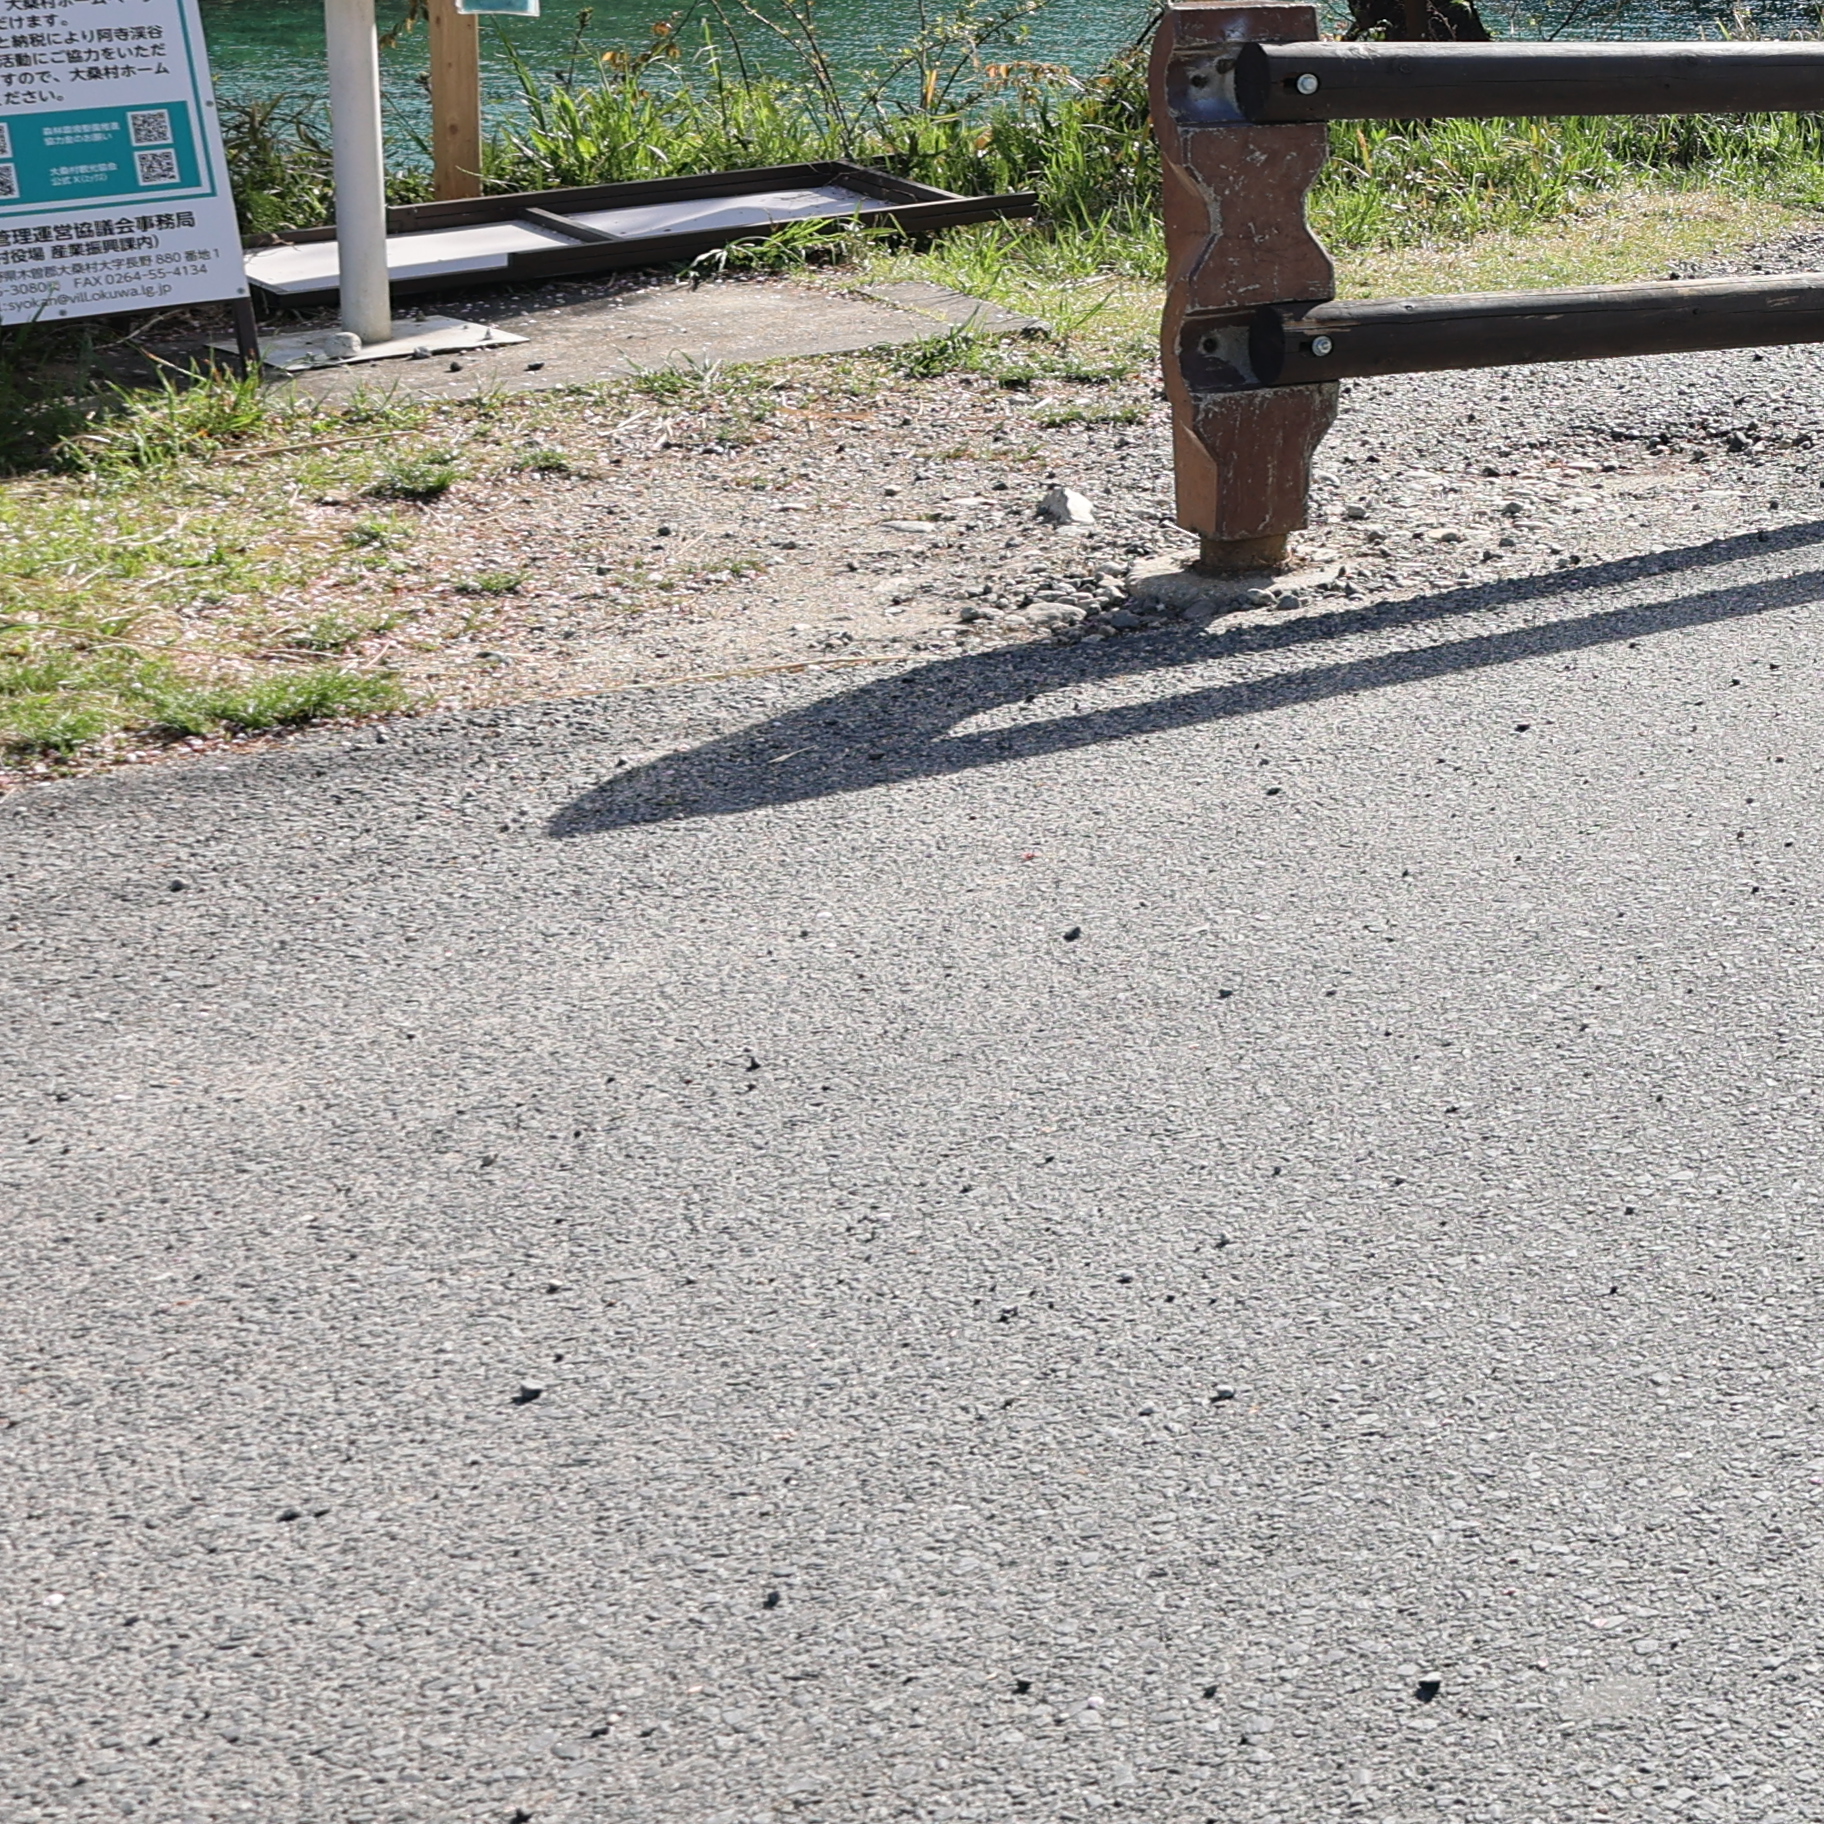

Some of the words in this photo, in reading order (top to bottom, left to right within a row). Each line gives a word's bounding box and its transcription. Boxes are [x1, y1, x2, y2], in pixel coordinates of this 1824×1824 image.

[156, 252, 182, 264] 880
[74, 276, 103, 288] FAX
[104, 264, 208, 285] 0264-55-4134
